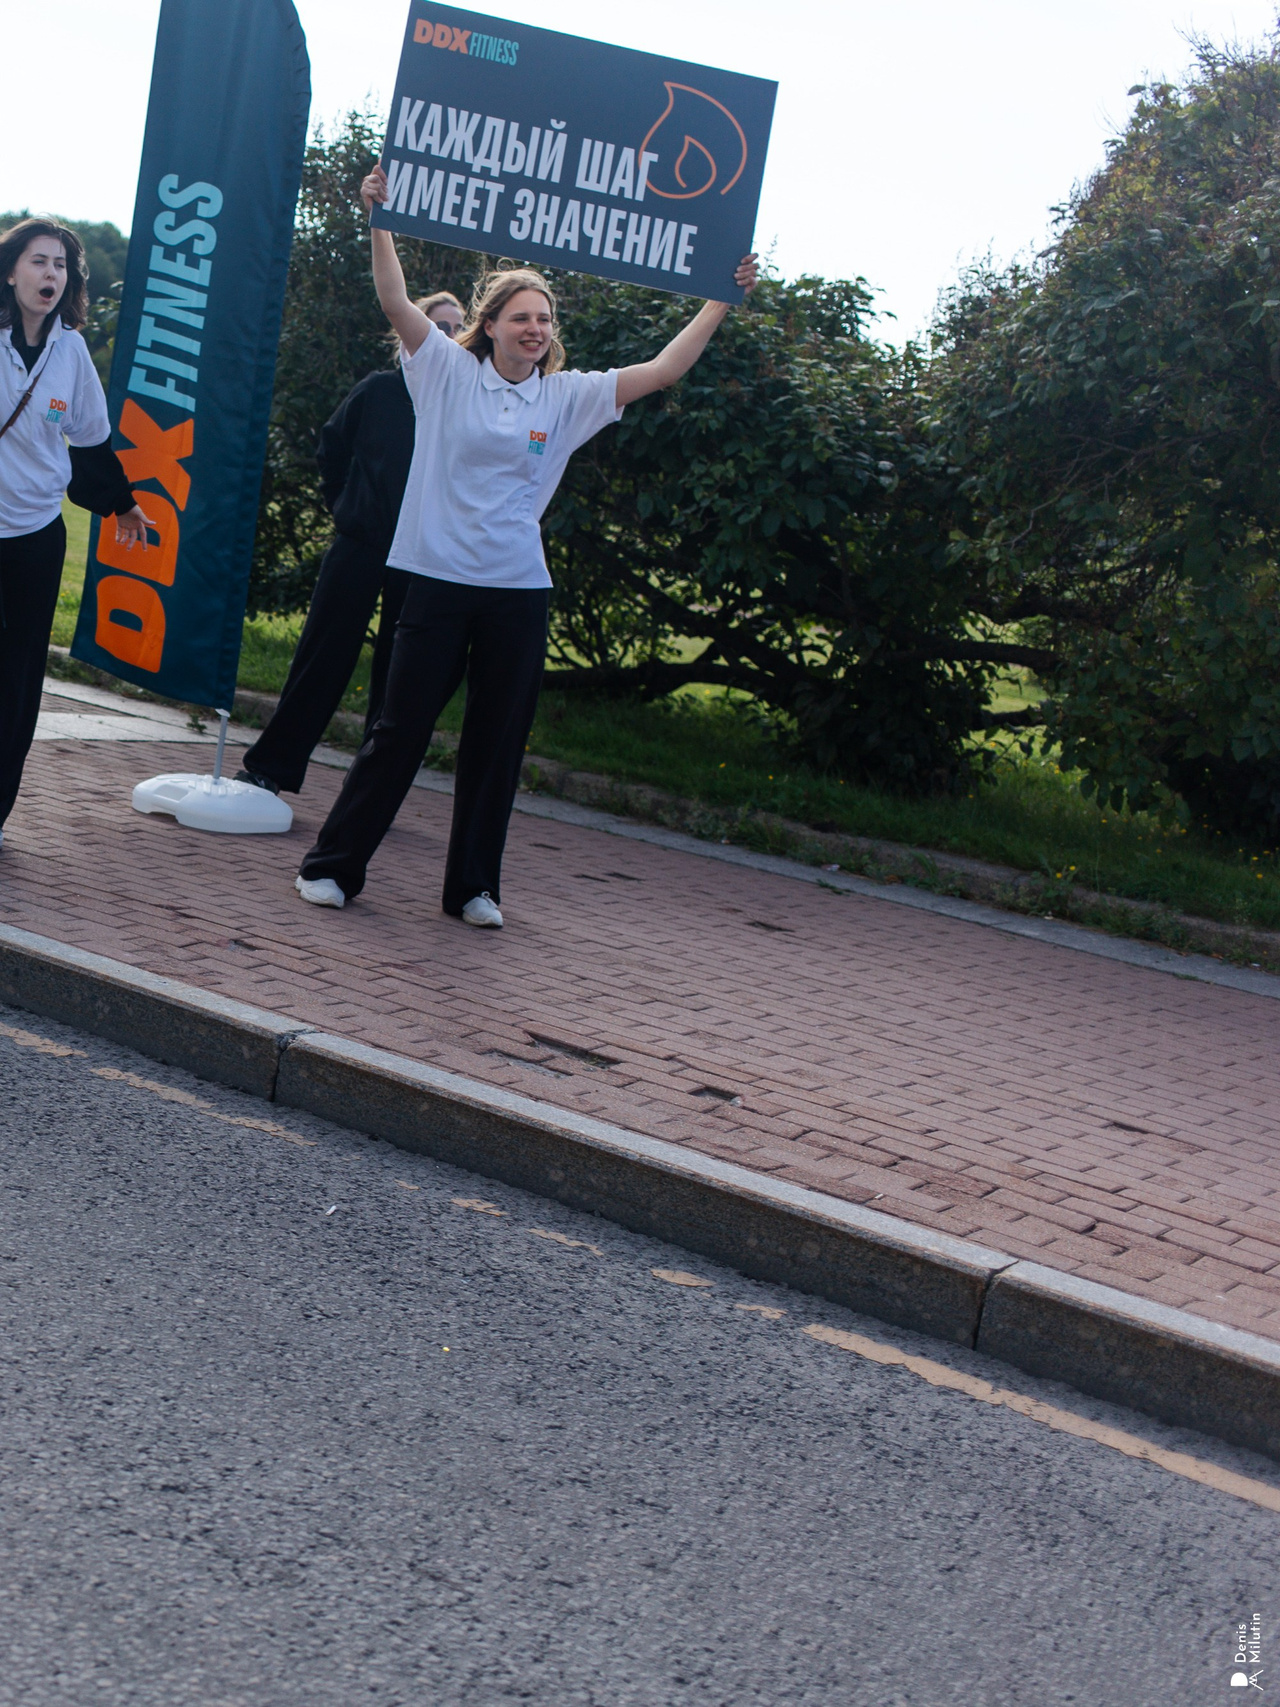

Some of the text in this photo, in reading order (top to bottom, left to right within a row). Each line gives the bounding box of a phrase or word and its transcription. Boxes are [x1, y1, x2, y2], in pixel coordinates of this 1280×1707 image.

[413, 18, 520, 66] DDX FITNESS
[393, 96, 659, 202] КАЖДЫЙ ШАГ
[382, 159, 698, 276] ИМЕЕТ ЗНАЧЕНИЕ
[93, 173, 223, 674] DDX FITNESS
